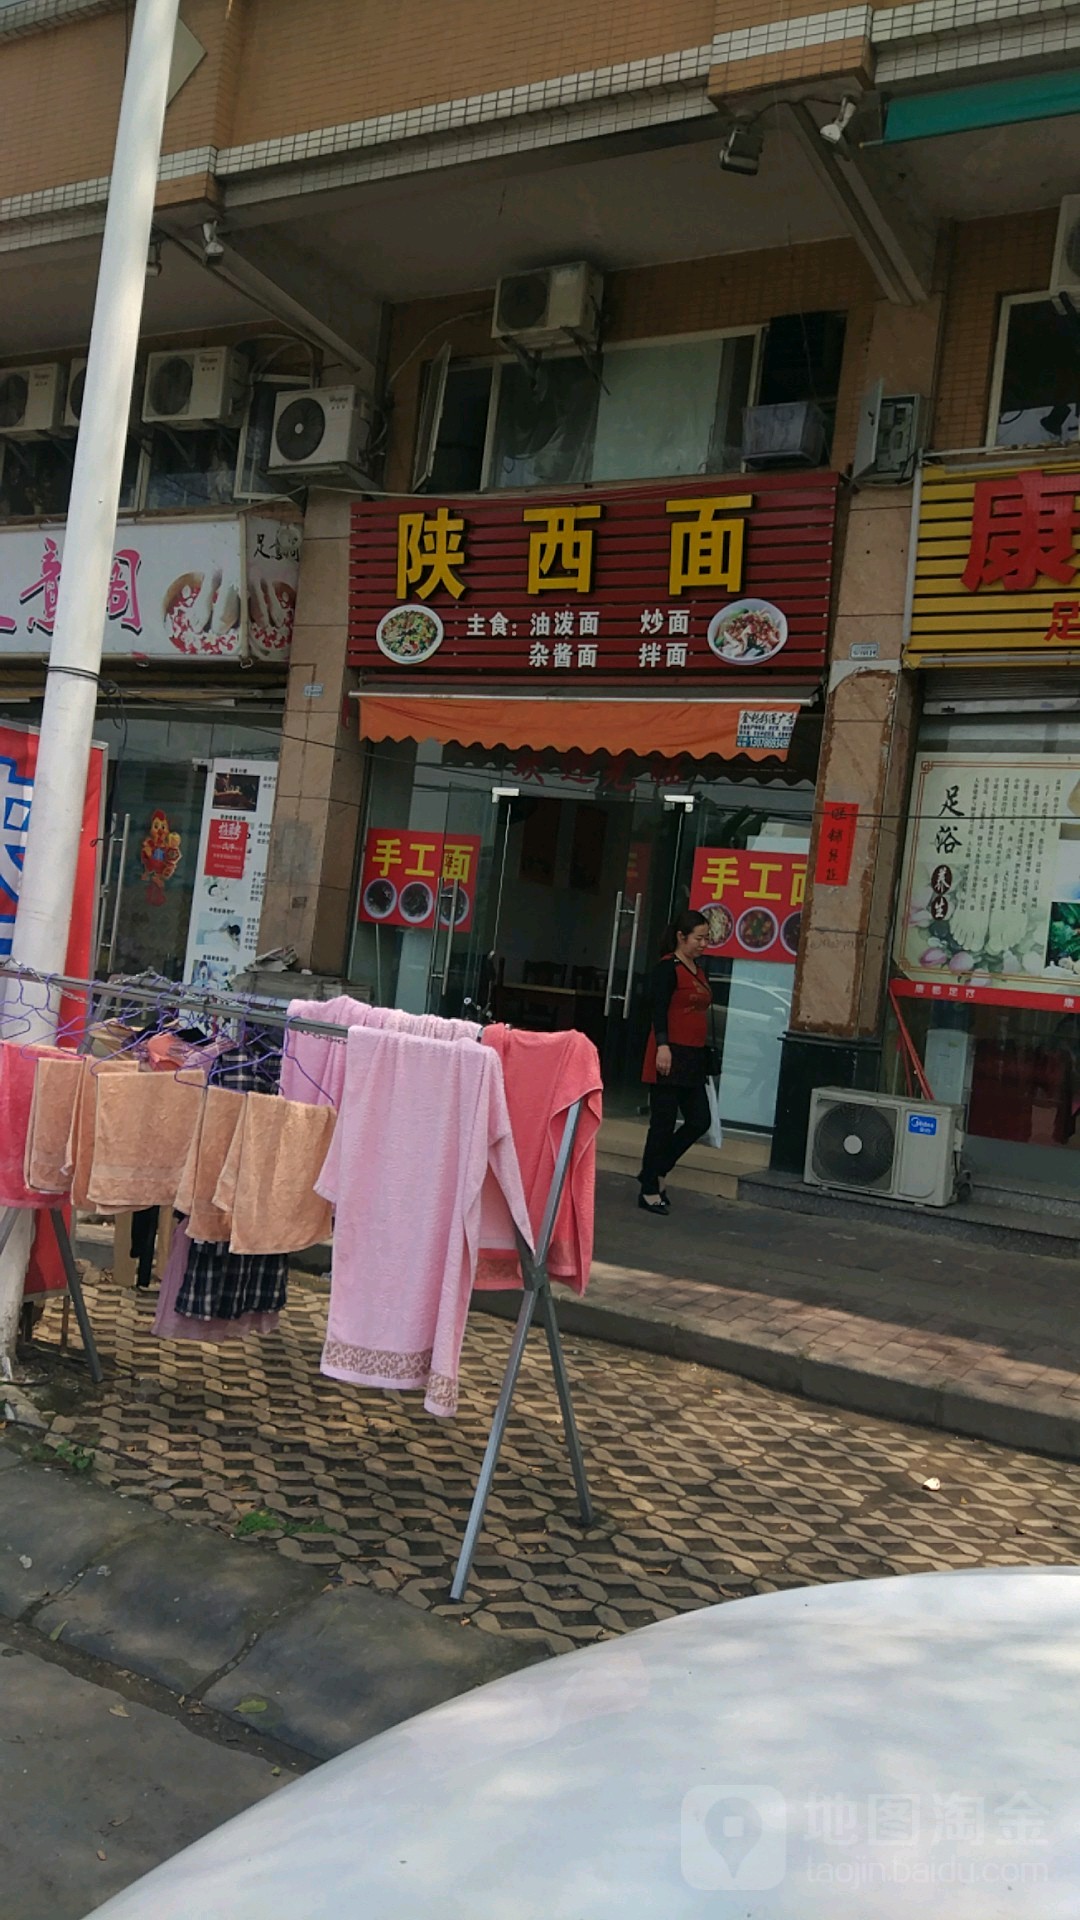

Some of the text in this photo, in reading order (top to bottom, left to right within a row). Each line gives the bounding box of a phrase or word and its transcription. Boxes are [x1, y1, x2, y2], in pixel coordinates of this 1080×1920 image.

[396, 494, 752, 600] 陕西面
[961, 470, 1080, 592] 康
[639, 608, 690, 635] 炒面
[1044, 601, 1080, 641] 足
[529, 641, 689, 668] 杂酱面 拌面
[938, 785, 965, 854] 足浴
[372, 838, 474, 884] 手工面
